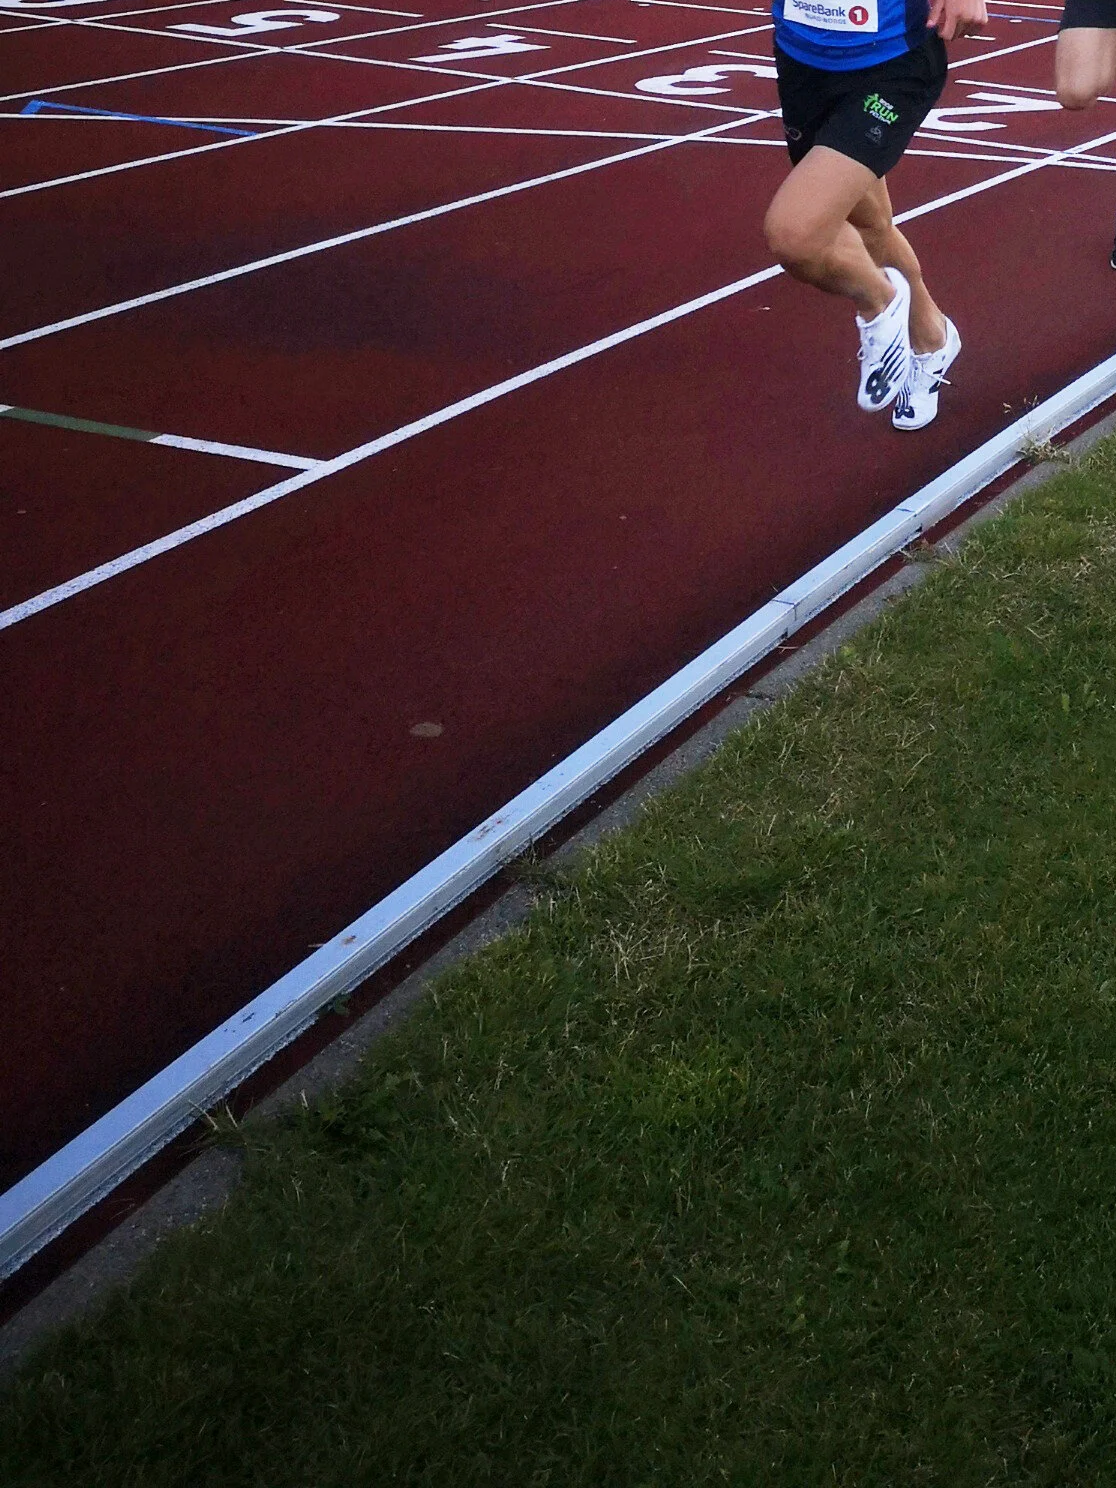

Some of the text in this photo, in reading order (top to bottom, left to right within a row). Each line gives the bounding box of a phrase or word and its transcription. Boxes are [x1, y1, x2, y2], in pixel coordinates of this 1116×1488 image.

[165, 9, 341, 37] 5
[408, 34, 553, 63] 4
[635, 64, 778, 96] 3
[870, 101, 899, 122] RUN
[920, 92, 1064, 132] 2
